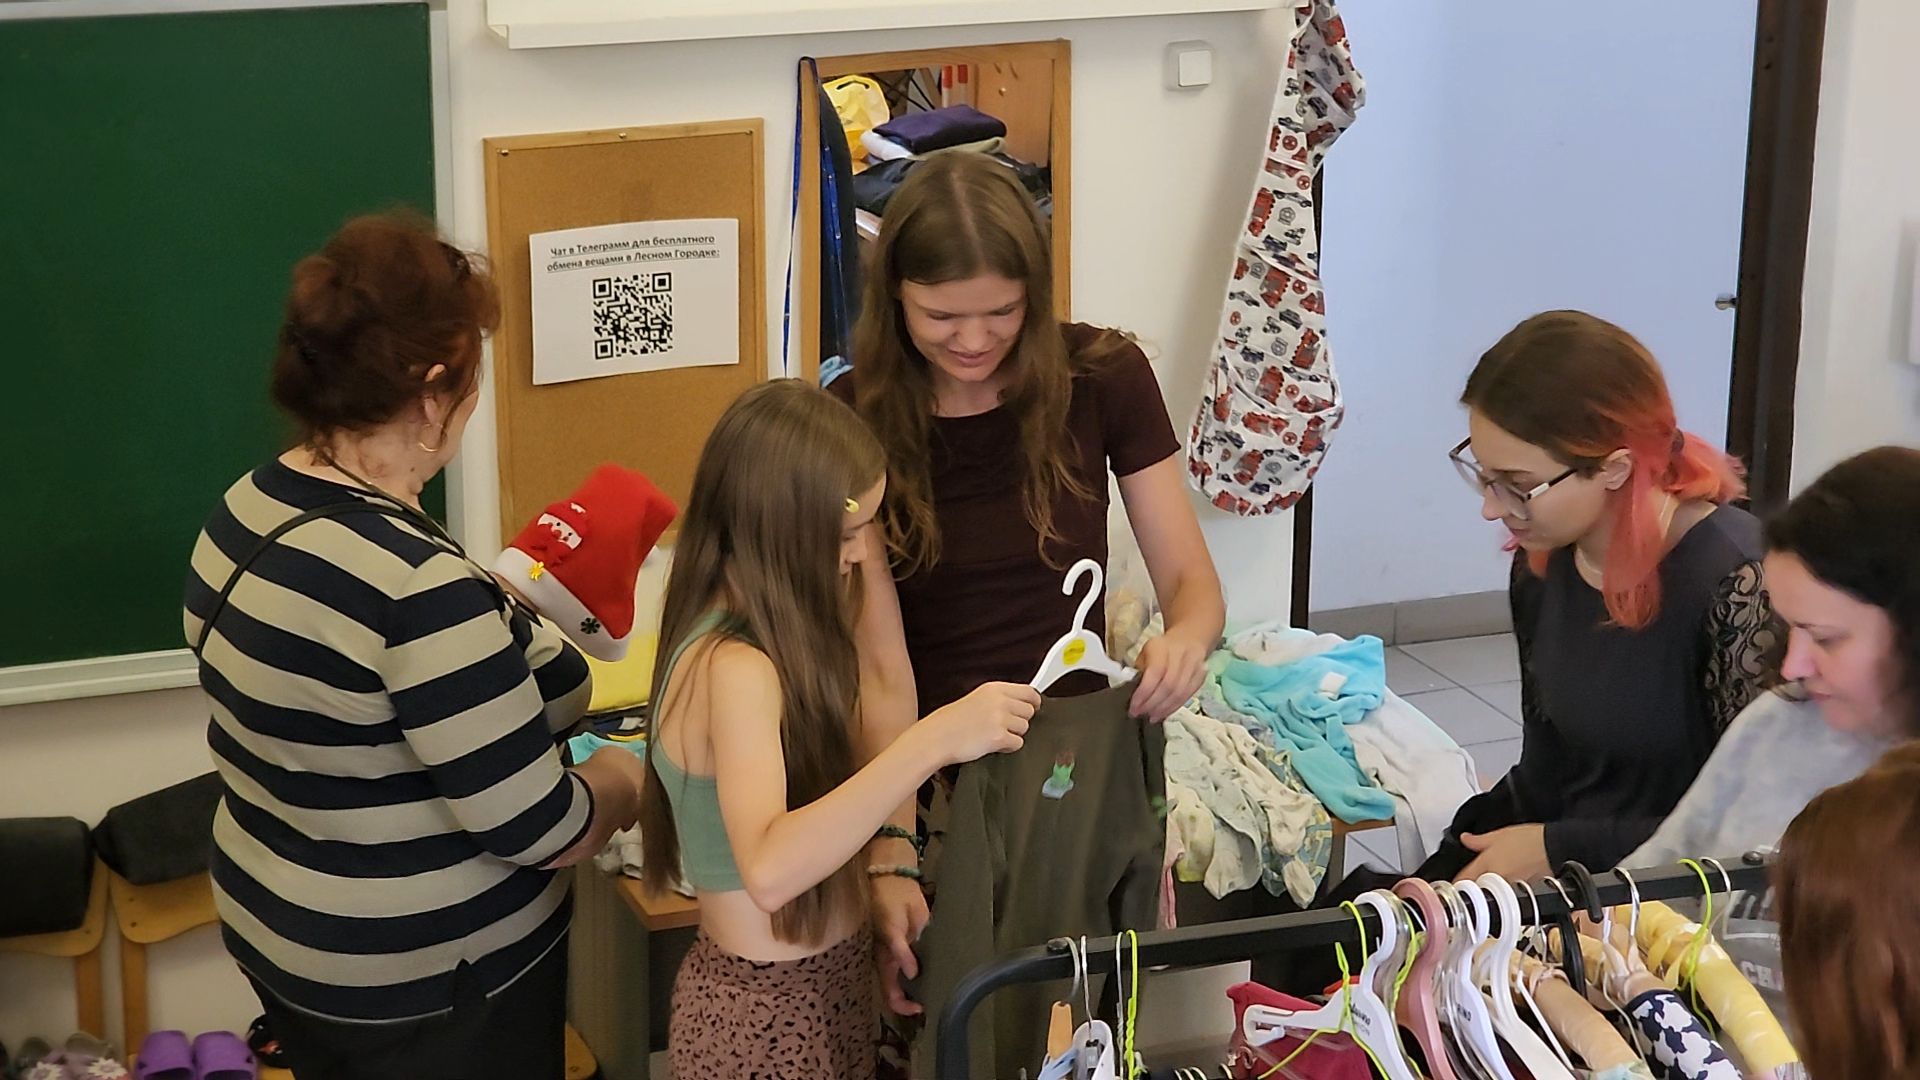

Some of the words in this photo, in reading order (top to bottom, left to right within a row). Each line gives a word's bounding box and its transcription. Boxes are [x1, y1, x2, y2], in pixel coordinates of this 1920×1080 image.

[550, 248, 566, 256] Чат
[576, 240, 630, 253] Телеграмм
[632, 239, 650, 249] для
[652, 236, 715, 246] бесплатного
[546, 259, 583, 271] обмена
[585, 255, 624, 267] вещами
[634, 251, 672, 261] Лесном
[674, 249, 720, 259] Городке:
